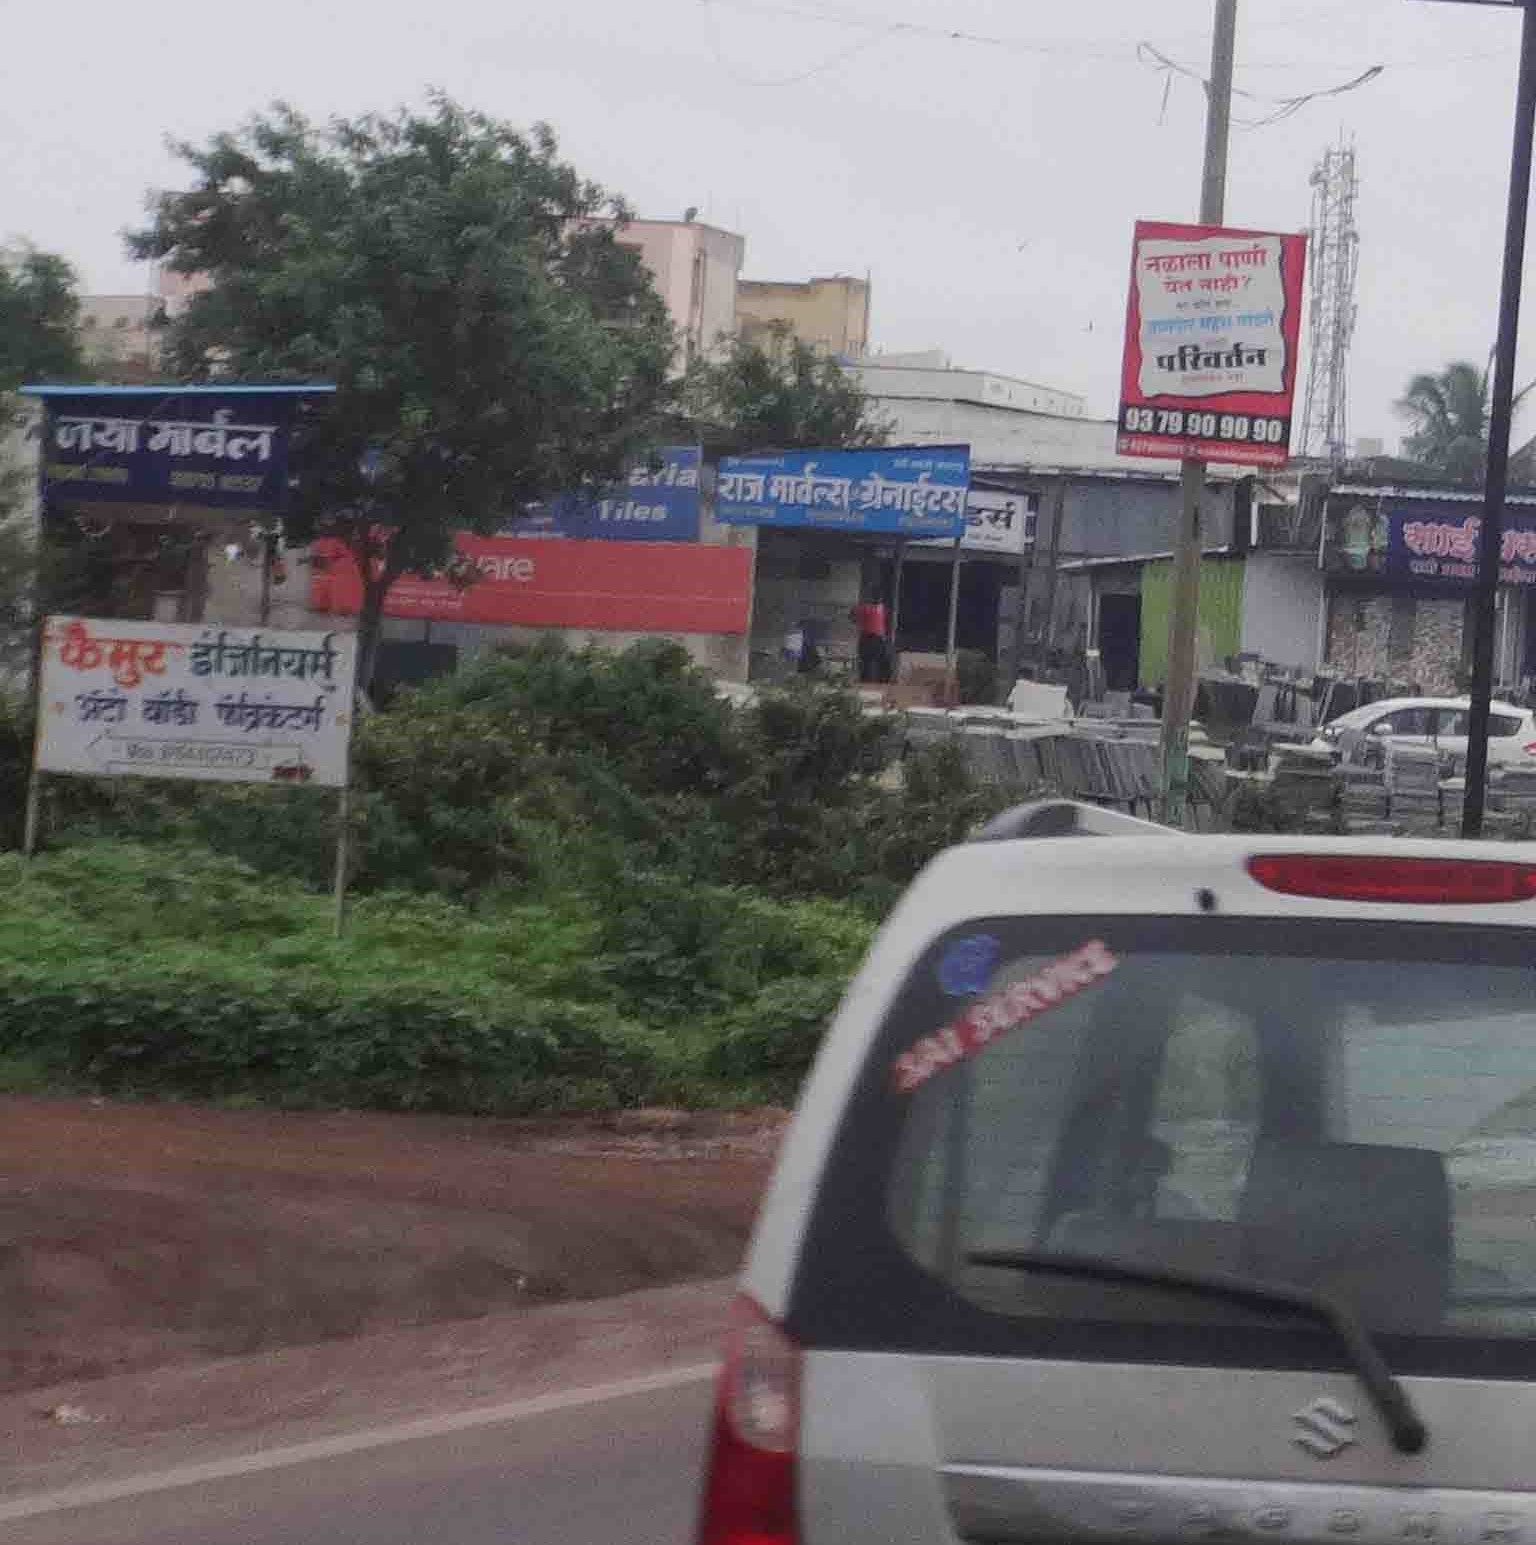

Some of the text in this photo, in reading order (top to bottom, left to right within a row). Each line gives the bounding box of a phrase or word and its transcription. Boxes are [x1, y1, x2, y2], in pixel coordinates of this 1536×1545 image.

[1156, 342, 1268, 373] परिवर्तन
[1124, 406, 1283, 443] 93 79 90 90 90
